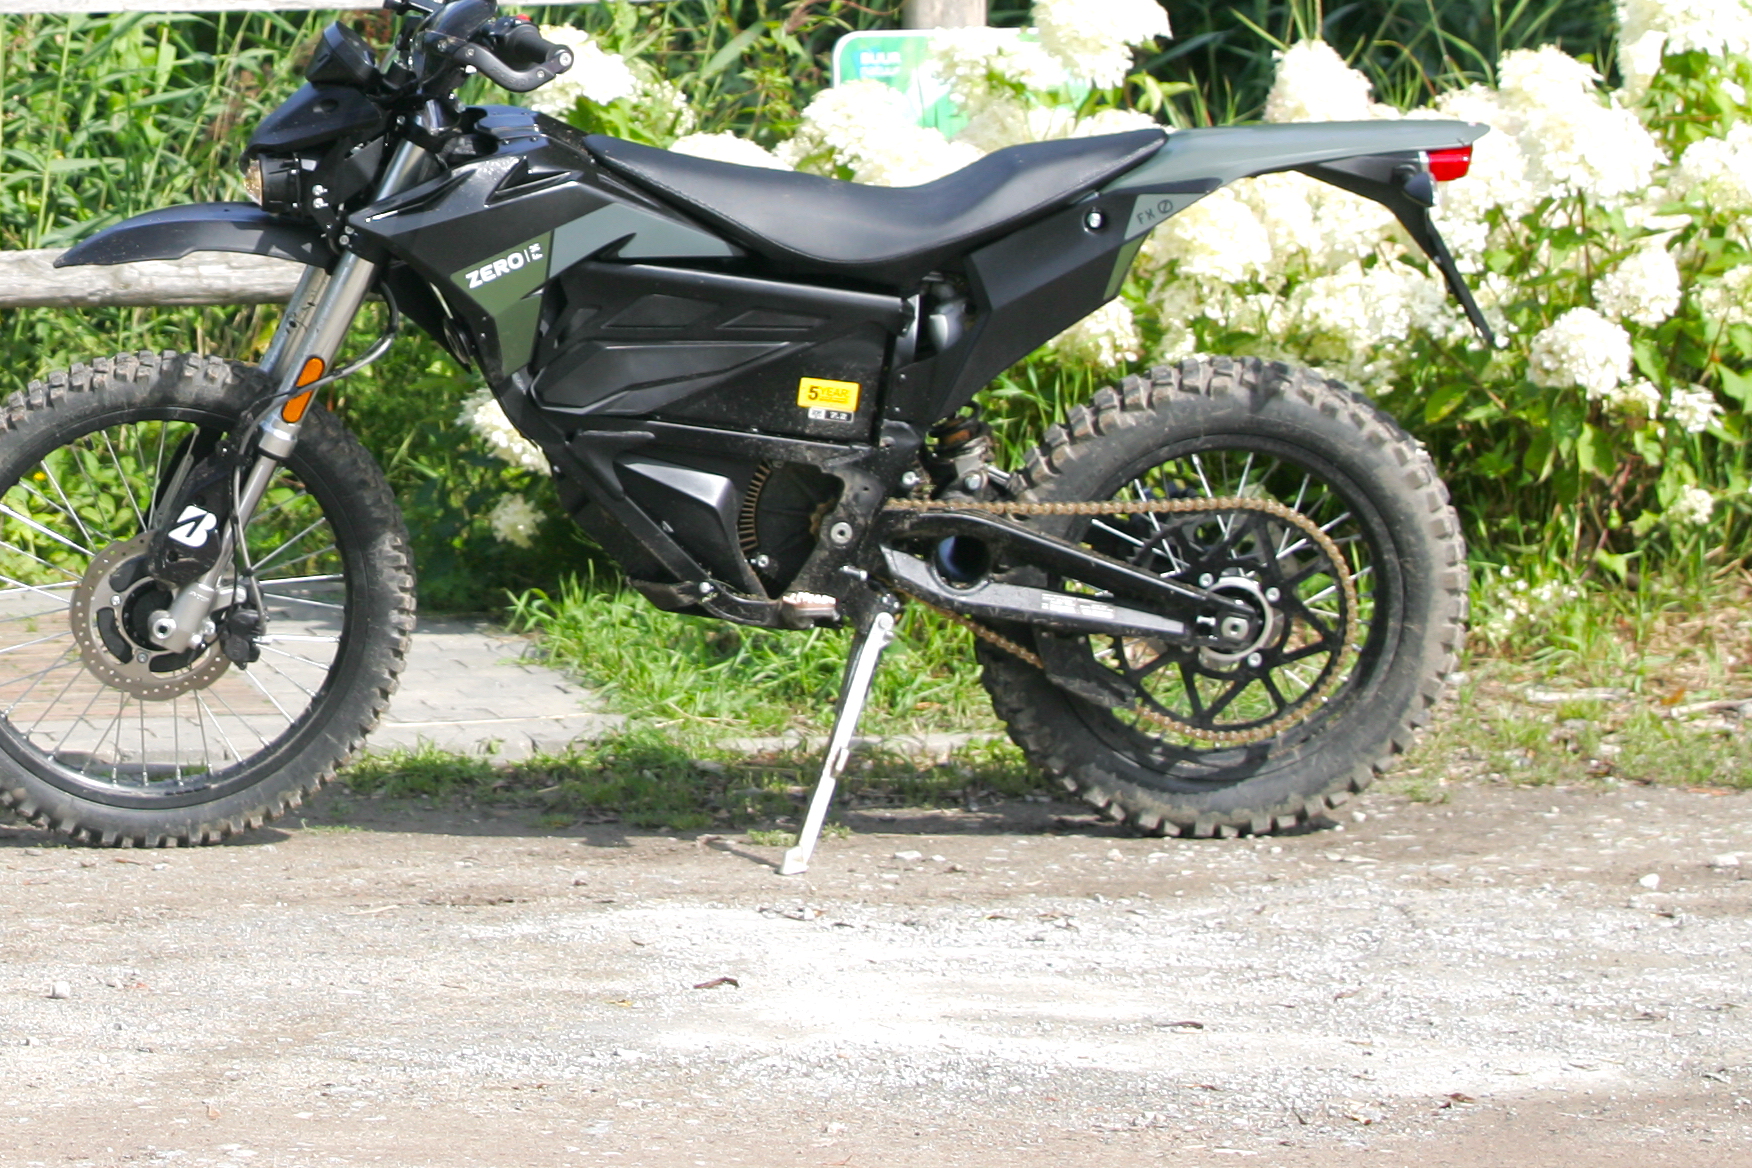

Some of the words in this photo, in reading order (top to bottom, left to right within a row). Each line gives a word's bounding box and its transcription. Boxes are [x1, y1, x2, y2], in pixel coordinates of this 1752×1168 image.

[1137, 208, 1155, 224] FX
[465, 252, 524, 289] ZERO
[808, 385, 819, 400] 5
[820, 387, 849, 398] YEAR
